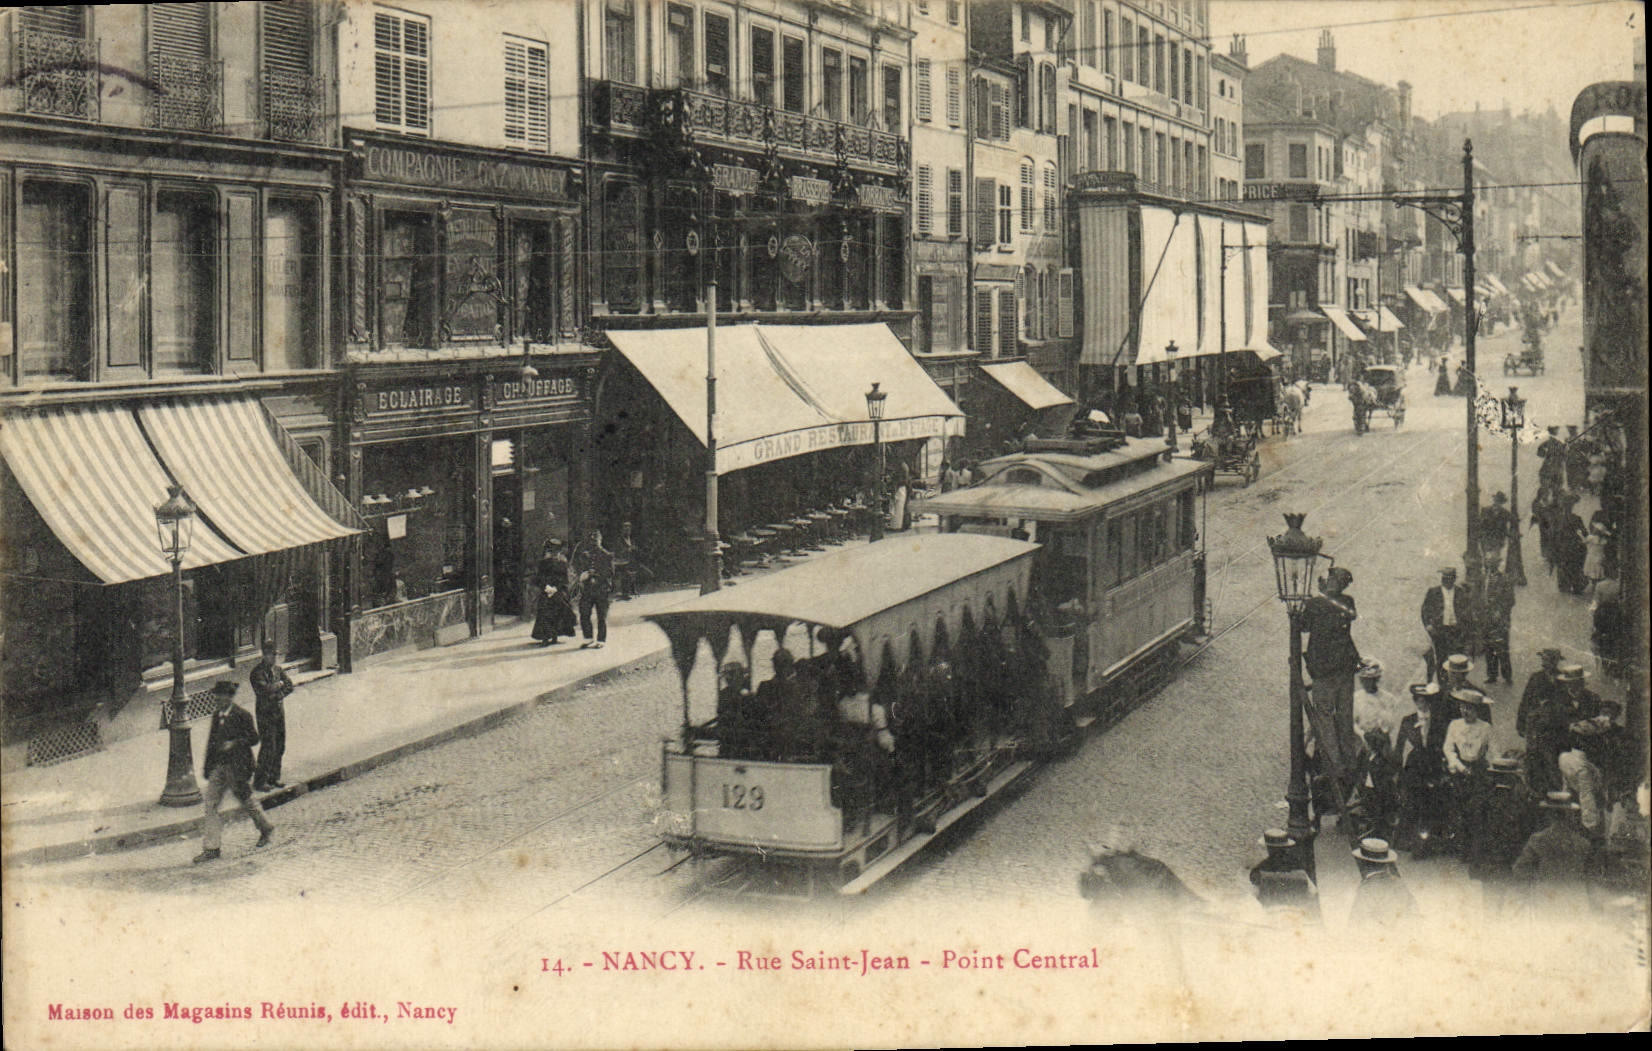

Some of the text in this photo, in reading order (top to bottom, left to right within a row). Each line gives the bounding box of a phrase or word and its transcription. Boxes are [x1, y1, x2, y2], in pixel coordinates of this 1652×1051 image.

[368, 147, 463, 185] COMPAGNIE
[478, 160, 508, 189] GAZ
[521, 165, 567, 195] NANCY
[715, 166, 757, 193] GRANDE
[378, 387, 462, 410] ECLAIRAGE
[754, 434, 801, 461] GRAND
[808, 421, 891, 448] RESTAURANT
[722, 783, 765, 811] 129
